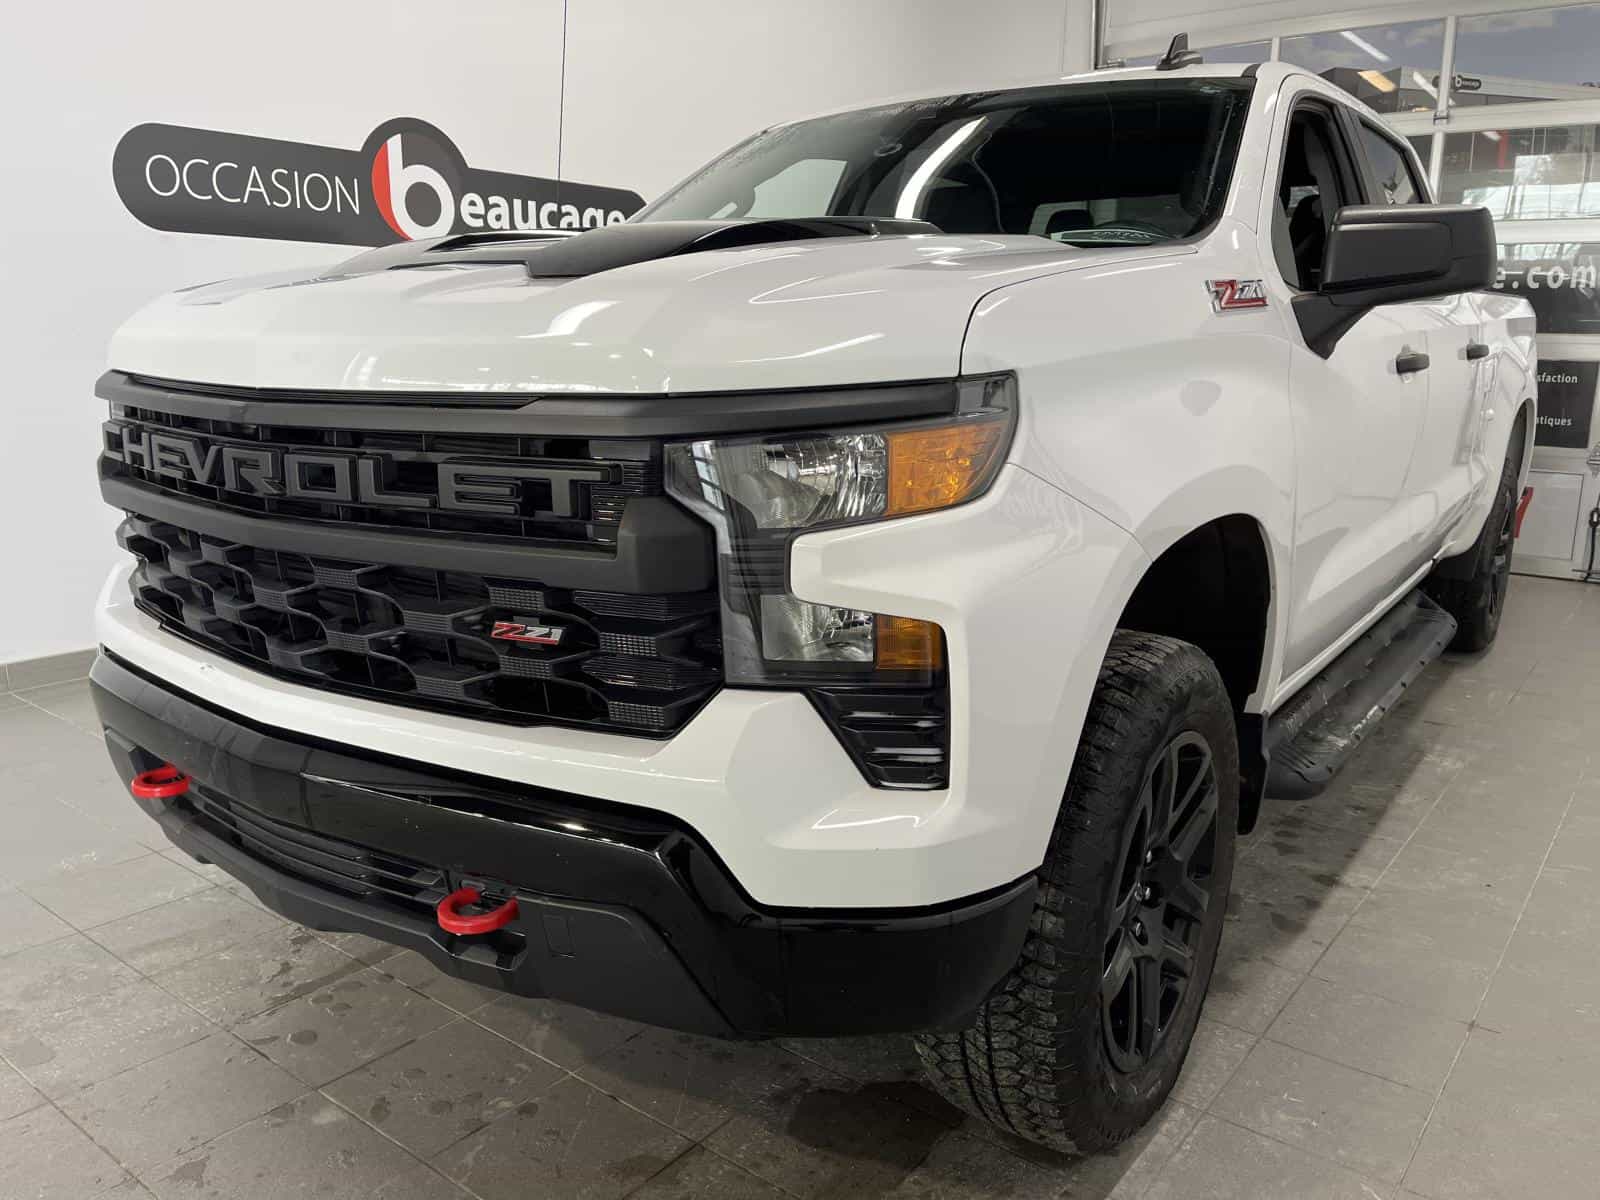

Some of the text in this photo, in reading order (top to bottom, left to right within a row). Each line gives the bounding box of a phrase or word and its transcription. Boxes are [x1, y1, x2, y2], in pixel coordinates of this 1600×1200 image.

[145, 154, 360, 215] OCCASION
[103, 419, 608, 517] CHEVROLET
[491, 621, 563, 645] Z71
